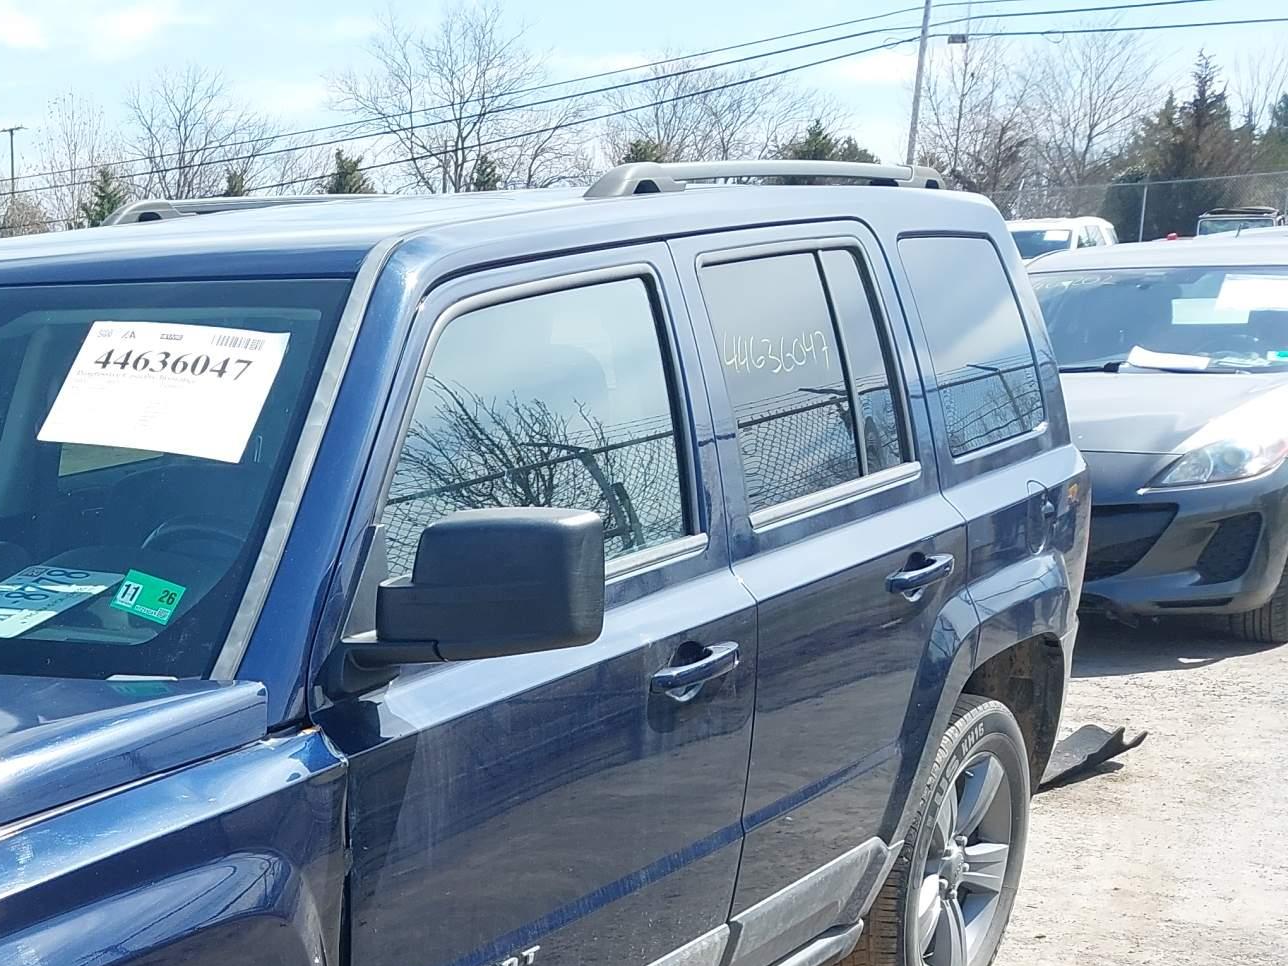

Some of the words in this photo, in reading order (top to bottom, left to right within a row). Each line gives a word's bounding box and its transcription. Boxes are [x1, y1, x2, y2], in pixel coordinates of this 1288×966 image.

[93, 348, 253, 381] 44636047
[722, 330, 830, 373] 44636047
[121, 583, 141, 602] 11
[157, 589, 178, 606] 26
[961, 722, 985, 757] KH16
